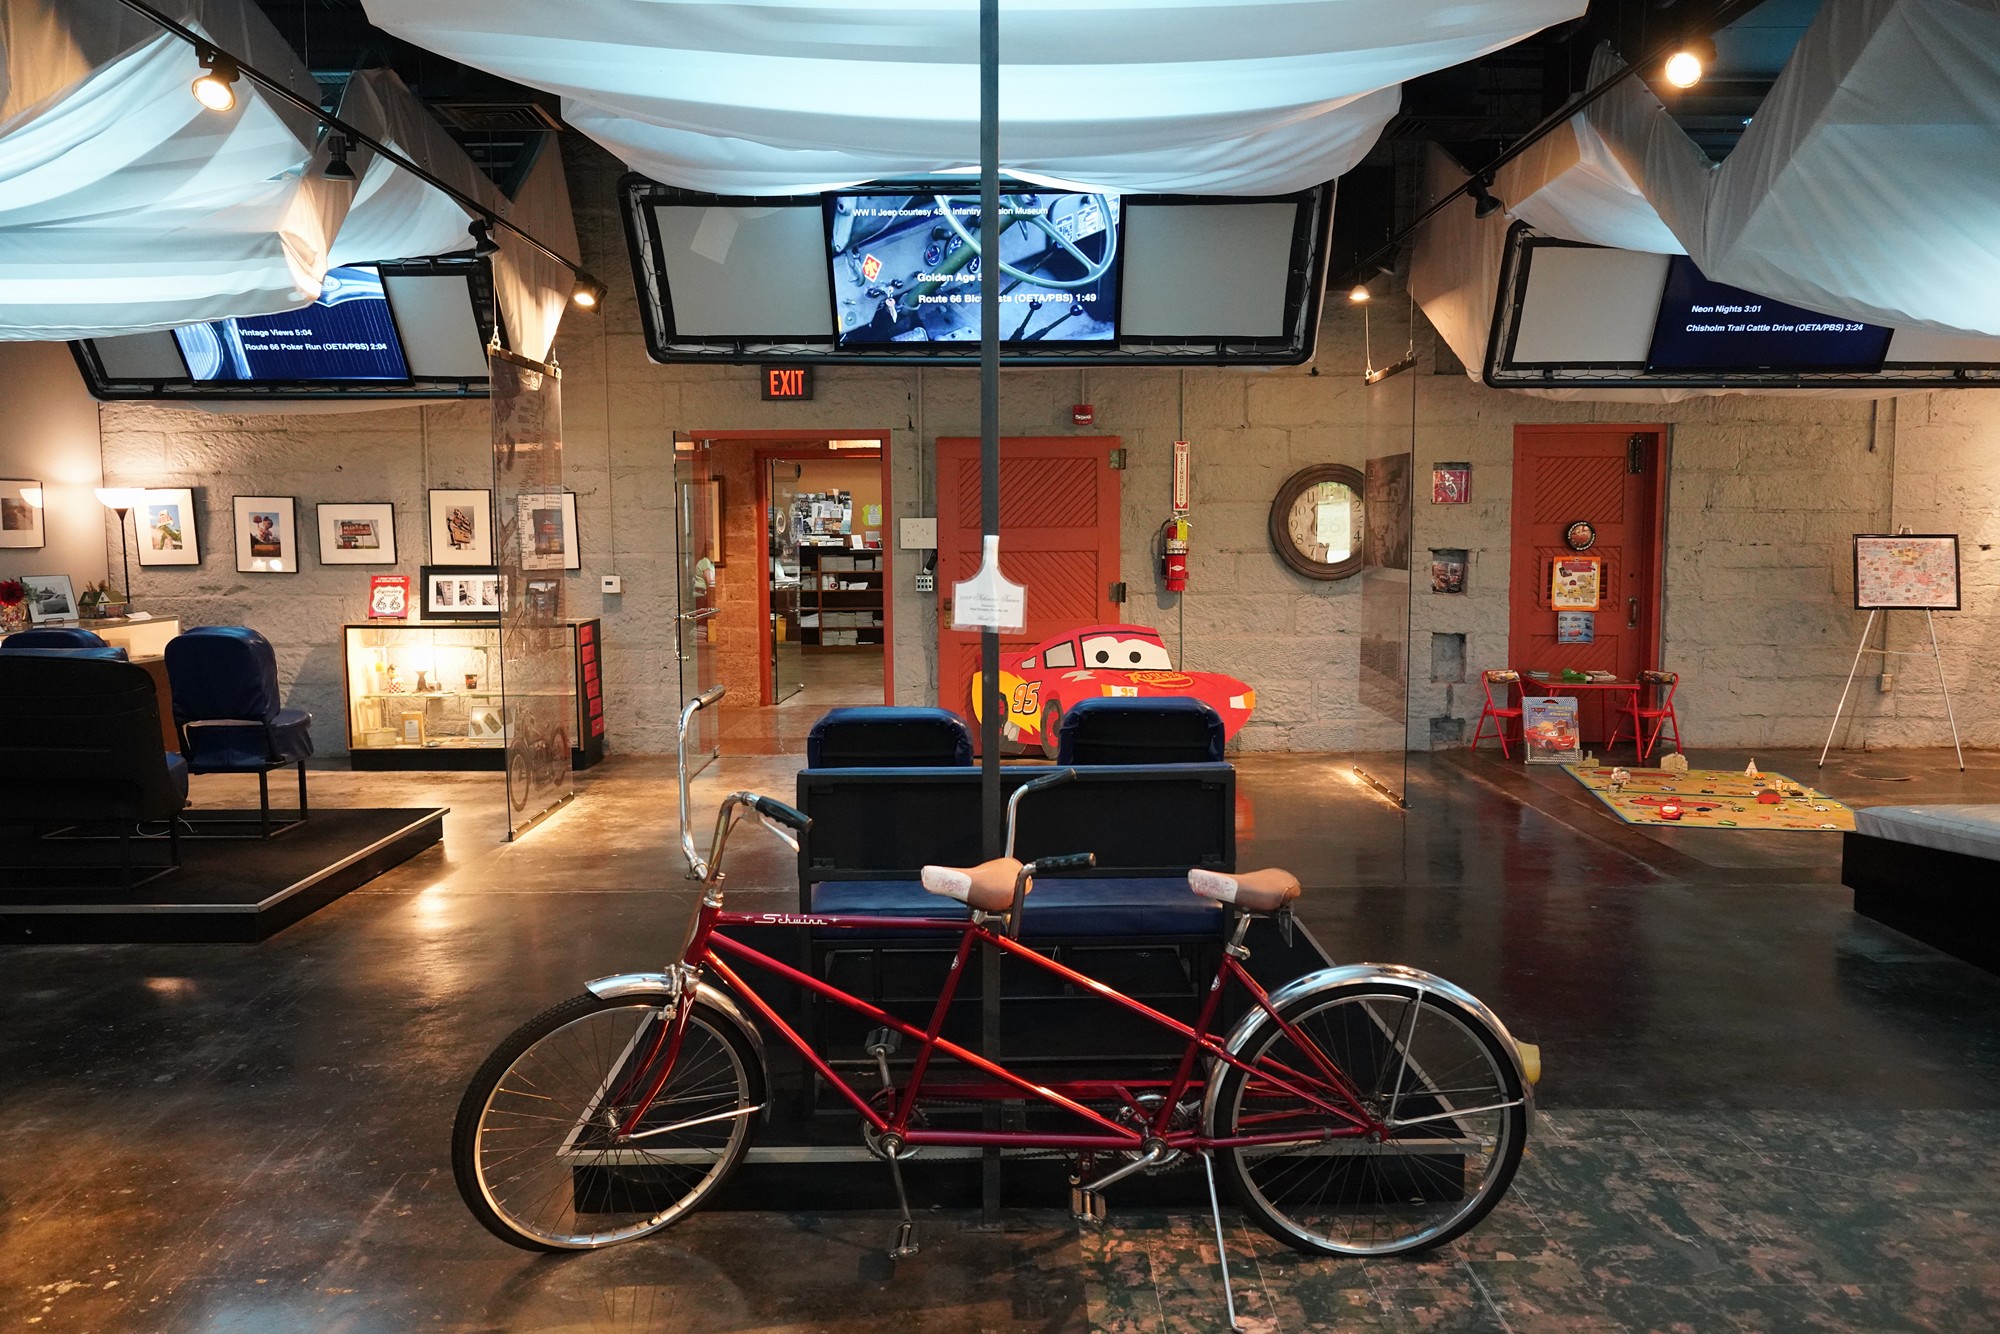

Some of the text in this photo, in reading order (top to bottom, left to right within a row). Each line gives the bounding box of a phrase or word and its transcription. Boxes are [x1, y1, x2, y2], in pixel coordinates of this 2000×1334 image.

[878, 209, 897, 218] Jeep
[899, 208, 931, 217] courtesy
[953, 208, 981, 217] Infantry
[1015, 207, 1049, 215] Museum
[917, 273, 952, 282] Golden
[955, 273, 976, 283] Age
[918, 294, 948, 303] Route
[949, 294, 962, 303] 66
[1014, 293, 1074, 304] (OETA/PBS)
[1075, 293, 1097, 302] 1:49
[1691, 305, 1762, 314] Neon Nights 3:01
[239, 329, 269, 337] Vintage
[1686, 323, 1863, 333] Chisholm Trail Cattle Drive (OETA/PBS) 3:24
[323, 343, 369, 351] (OETA/PBS)
[769, 369, 805, 396] EXIT
[1176, 445, 1187, 453] FIRE
[1307, 491, 1315, 503] 11
[1295, 505, 1306, 517] 10
[1353, 500, 1361, 512] 2
[1290, 519, 1299, 531] 9
[1295, 533, 1304, 546] 8
[1353, 530, 1362, 542] 4
[376, 596, 400, 610] 66
[1012, 680, 1043, 715] 95
[1120, 687, 1135, 697] 95
[754, 913, 828, 925] Schwinn
